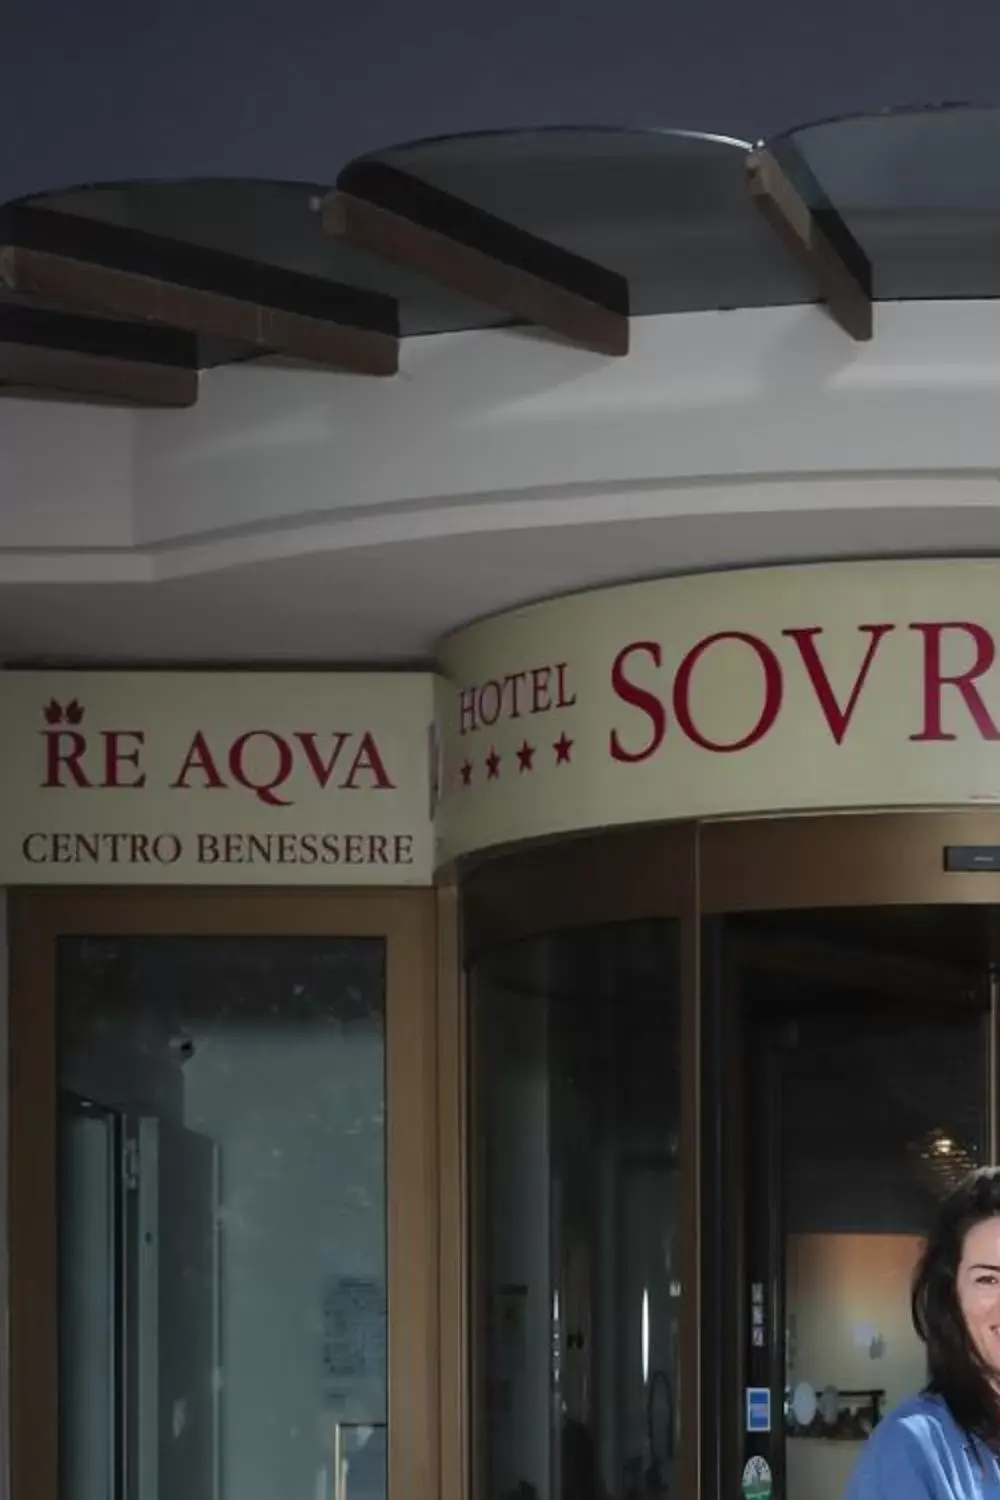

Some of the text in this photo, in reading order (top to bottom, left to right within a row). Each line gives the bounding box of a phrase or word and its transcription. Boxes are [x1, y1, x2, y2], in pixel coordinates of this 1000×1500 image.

[458, 662, 576, 736] HOTEL
[40, 729, 397, 806] RE AQVA
[22, 831, 415, 866] CENTRO BENESSERE
